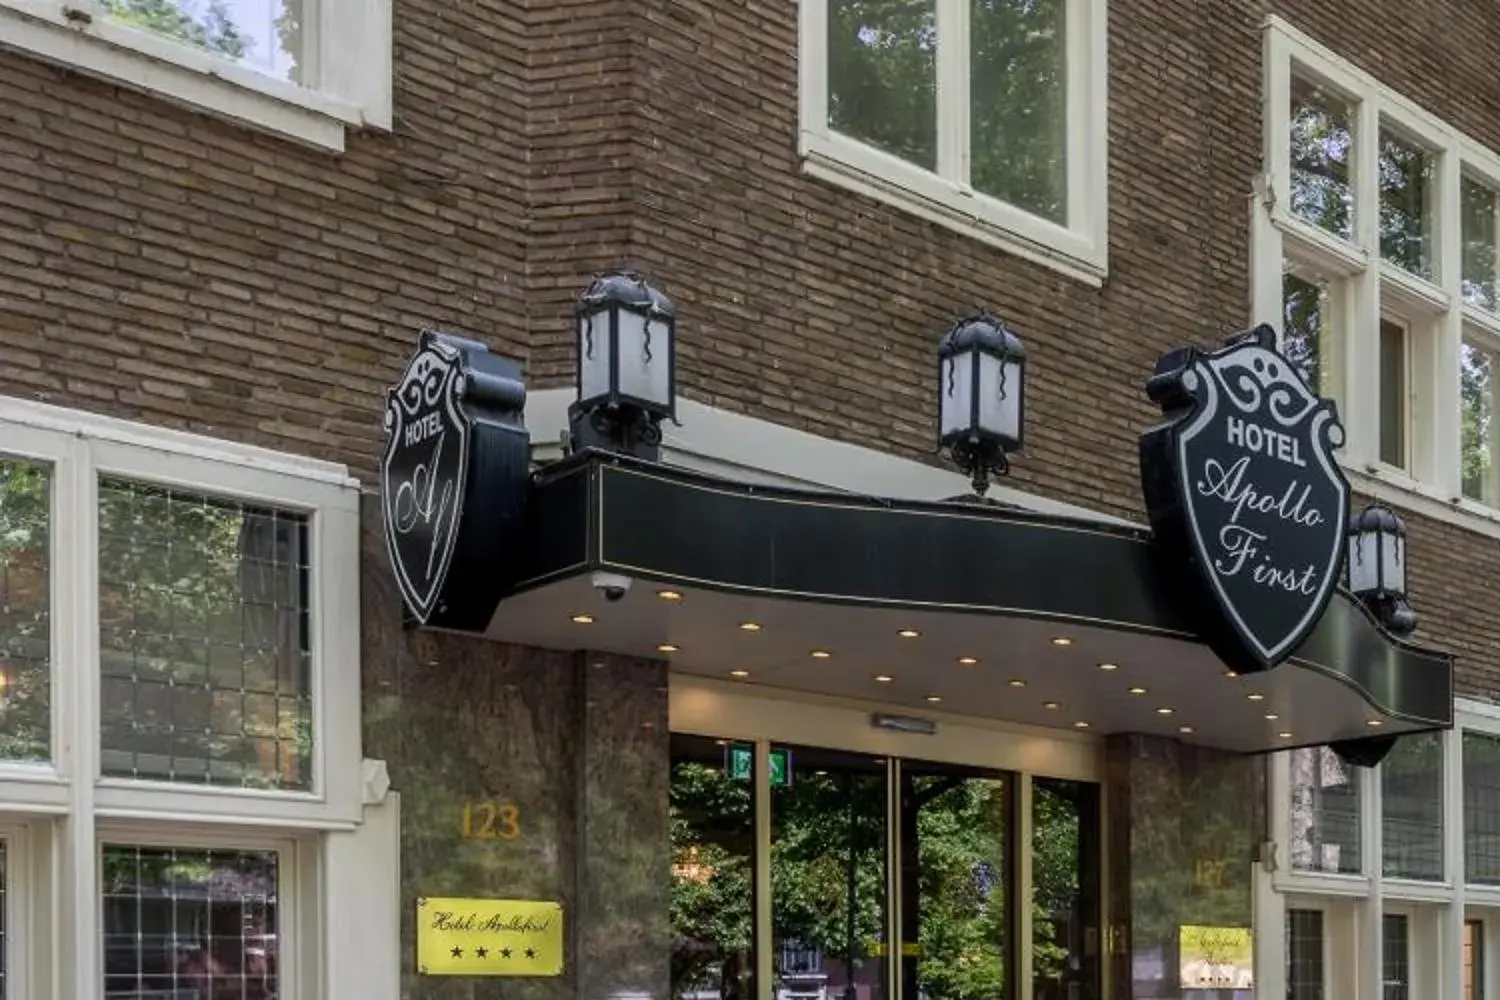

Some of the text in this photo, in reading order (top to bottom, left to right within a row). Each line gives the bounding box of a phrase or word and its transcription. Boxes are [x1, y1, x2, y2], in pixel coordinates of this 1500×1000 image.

[405, 411, 445, 447] HOTEL
[1227, 416, 1307, 467] HOTEL
[1197, 456, 1325, 527] Apollo
[1215, 524, 1316, 595] First
[460, 801, 521, 842] 123
